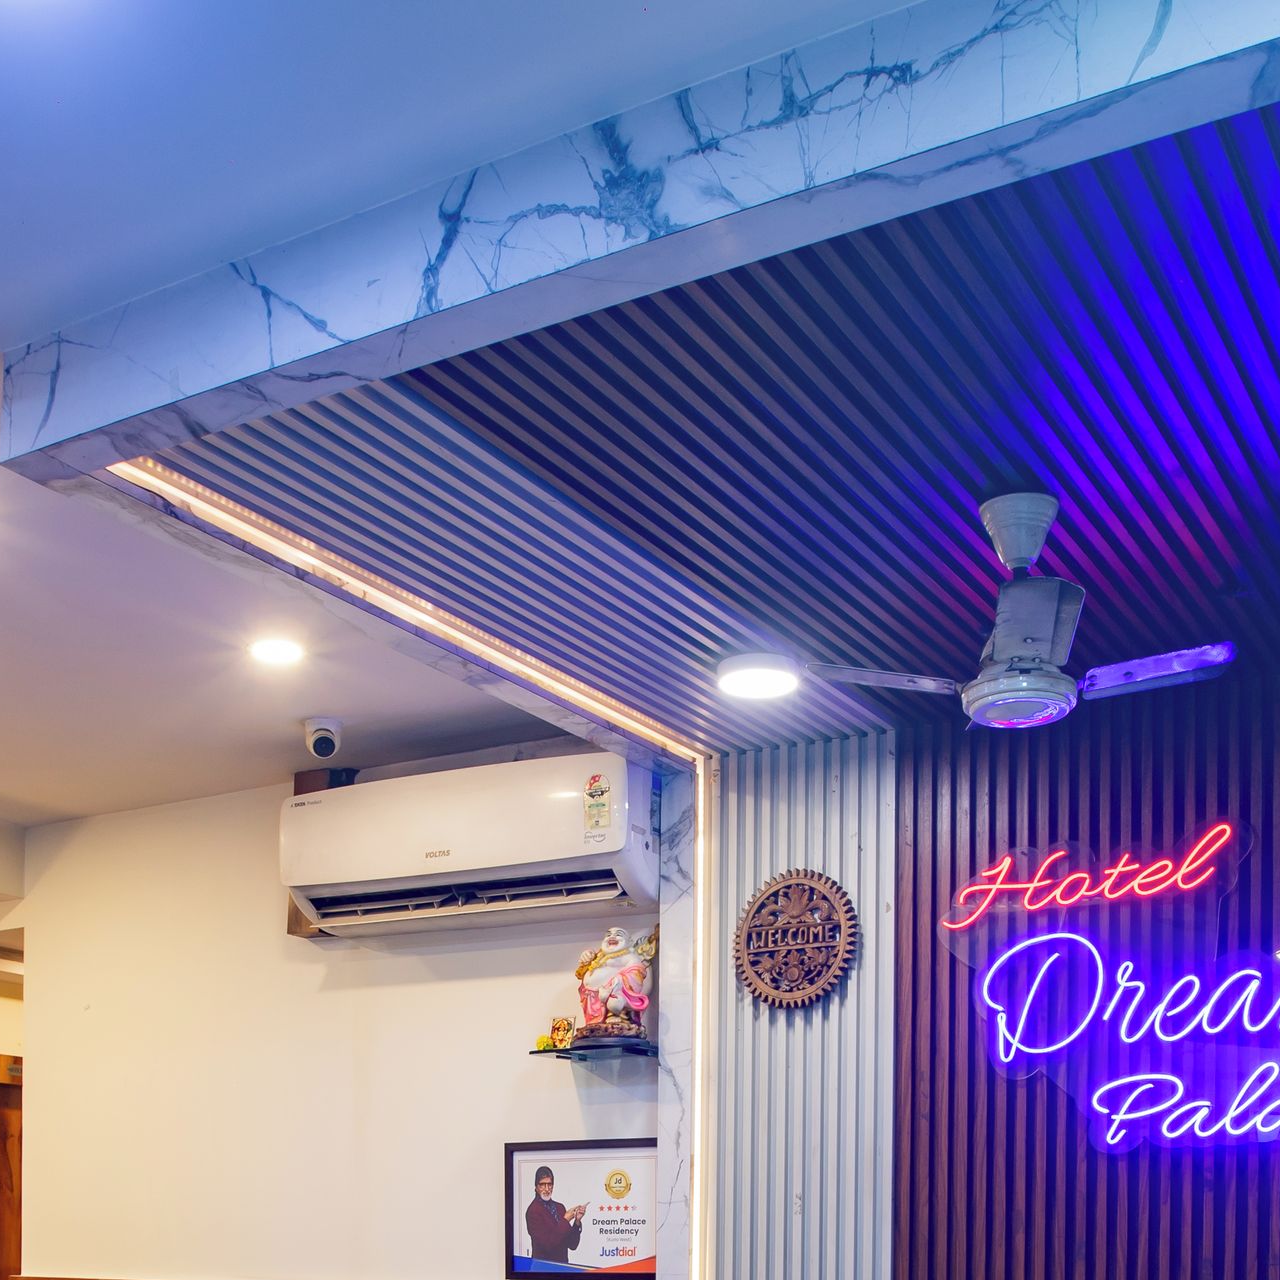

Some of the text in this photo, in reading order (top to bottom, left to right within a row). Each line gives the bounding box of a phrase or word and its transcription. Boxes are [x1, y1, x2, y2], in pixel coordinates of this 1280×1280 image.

[424, 849, 451, 859] VOLTAS
[941, 822, 1233, 932] Hotel
[751, 924, 835, 950] WELCOME
[592, 1217, 647, 1226] Dream Palace
[599, 1227, 639, 1236] Residency
[600, 1246, 636, 1257] Justdial
